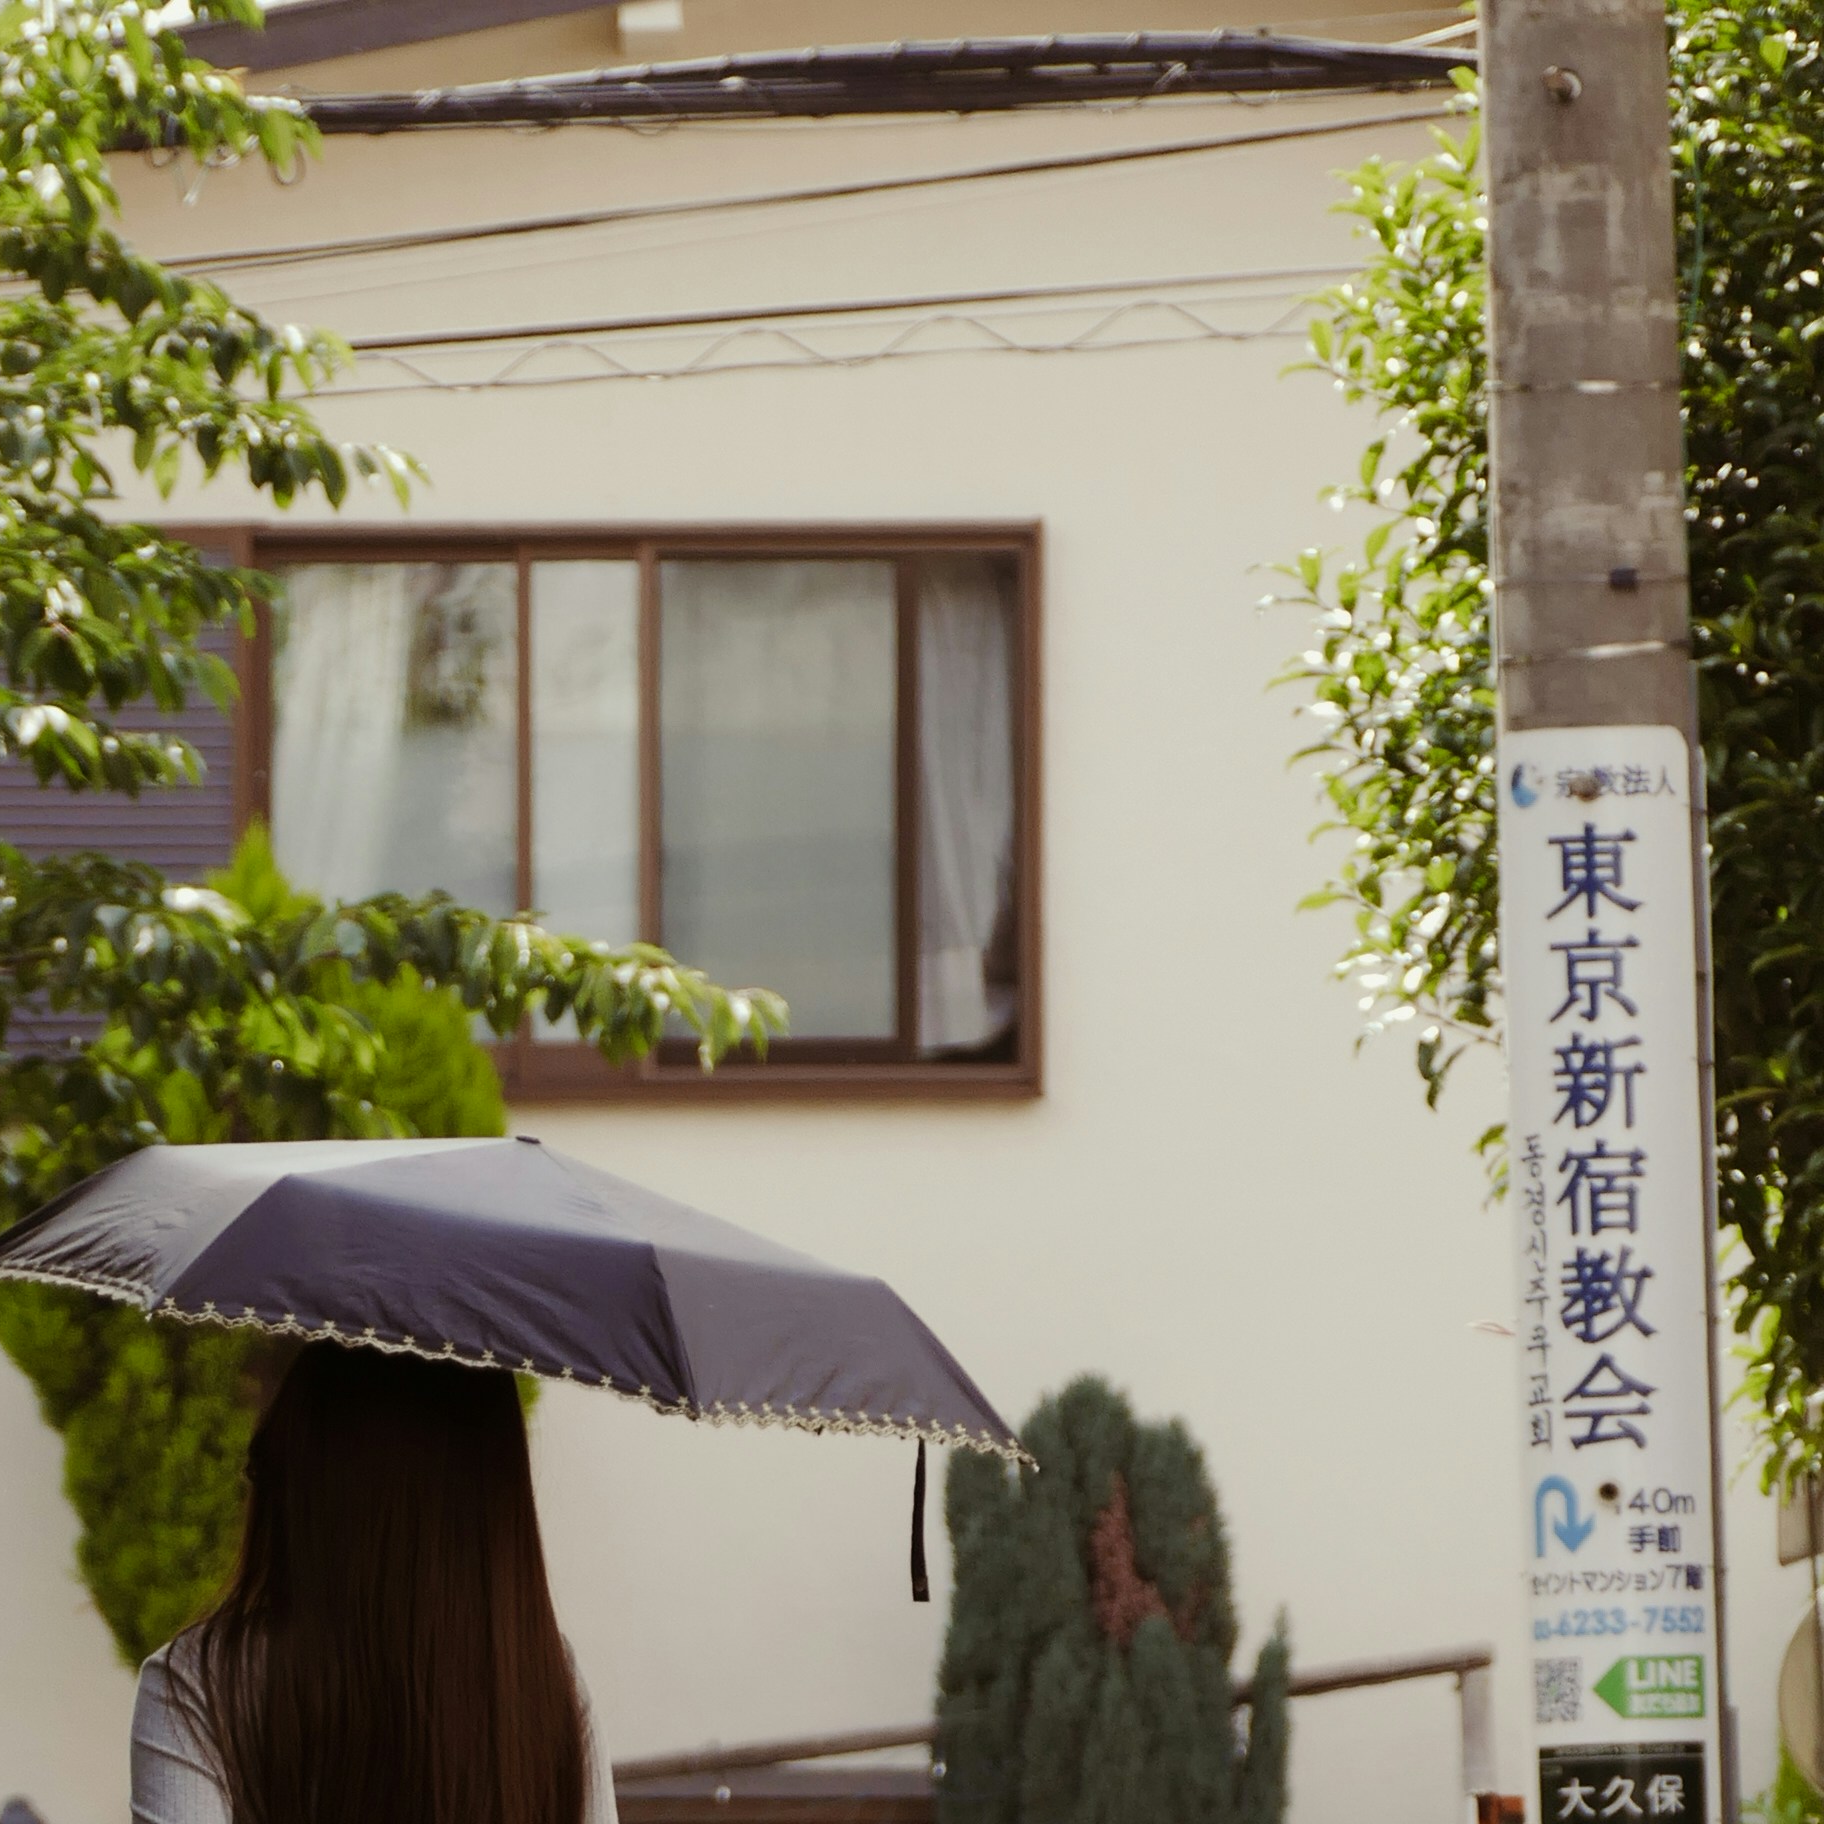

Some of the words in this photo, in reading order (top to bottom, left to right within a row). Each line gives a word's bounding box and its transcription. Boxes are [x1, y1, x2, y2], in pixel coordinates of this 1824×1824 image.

[1545, 822, 1656, 1450] 東京新宿教会
[1627, 1659, 1698, 1689] LINE
[1557, 1774, 1686, 1819] 大久保
